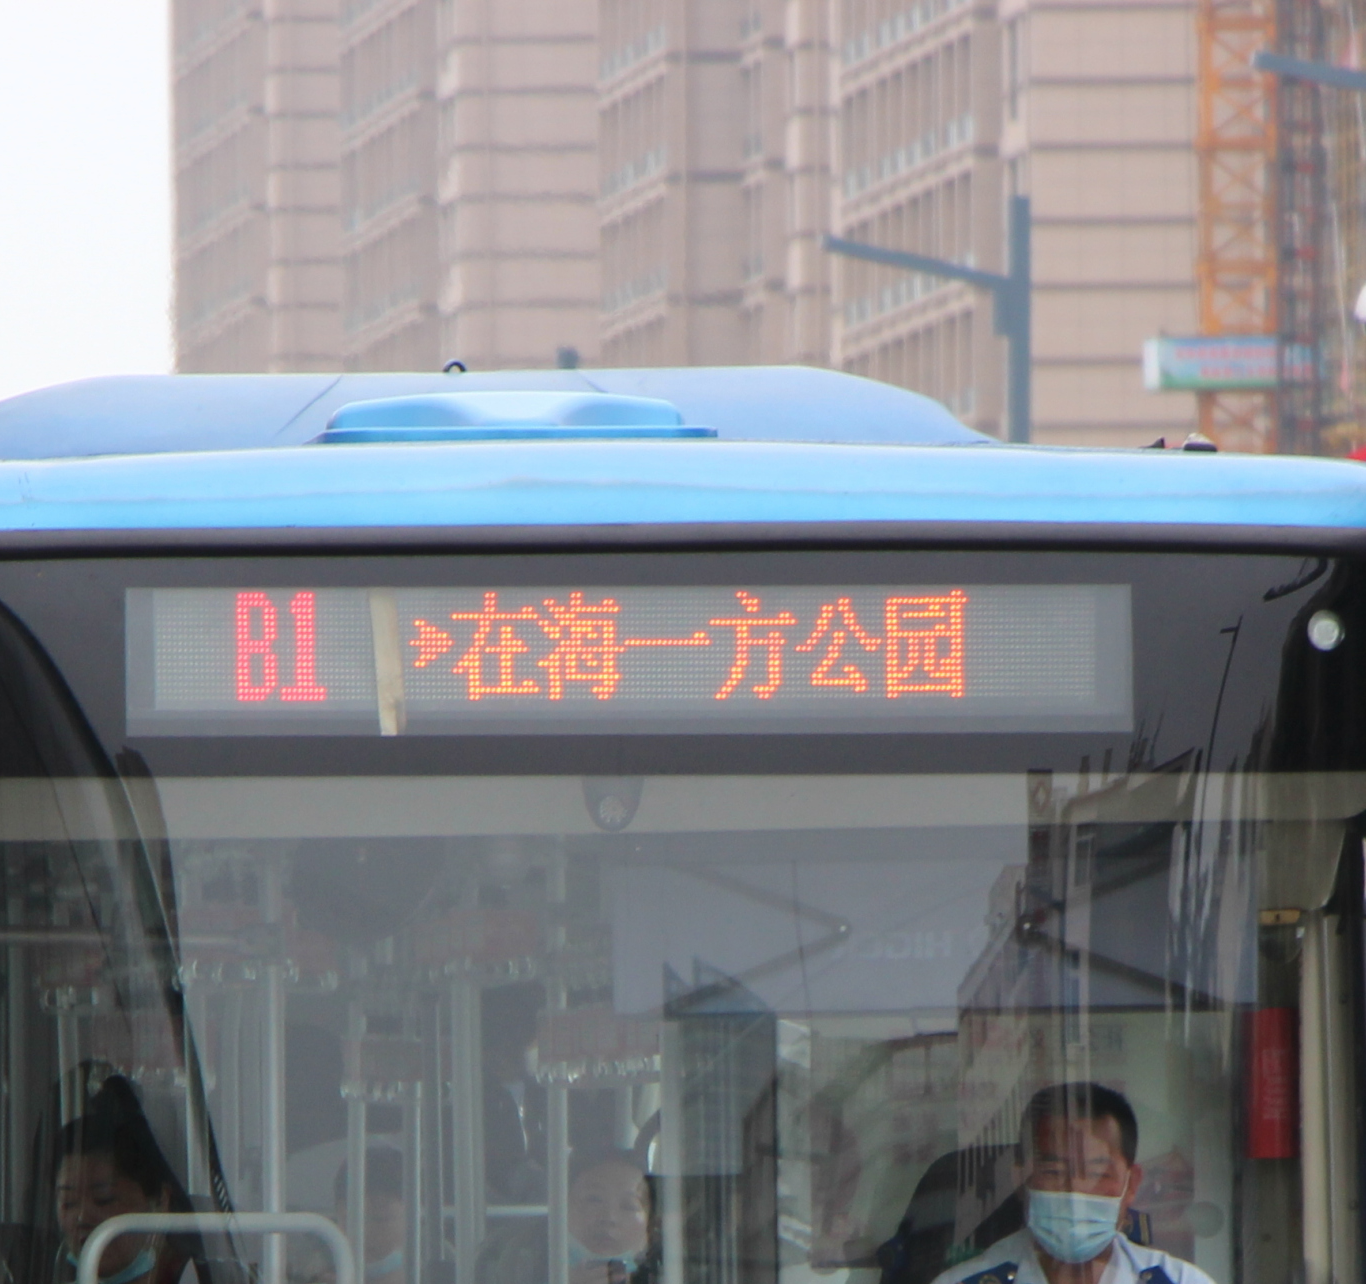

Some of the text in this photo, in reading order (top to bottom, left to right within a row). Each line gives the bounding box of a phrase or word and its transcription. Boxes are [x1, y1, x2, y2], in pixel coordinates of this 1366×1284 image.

[236, 590, 327, 701] B1
[451, 589, 968, 700] 在海一方公园
